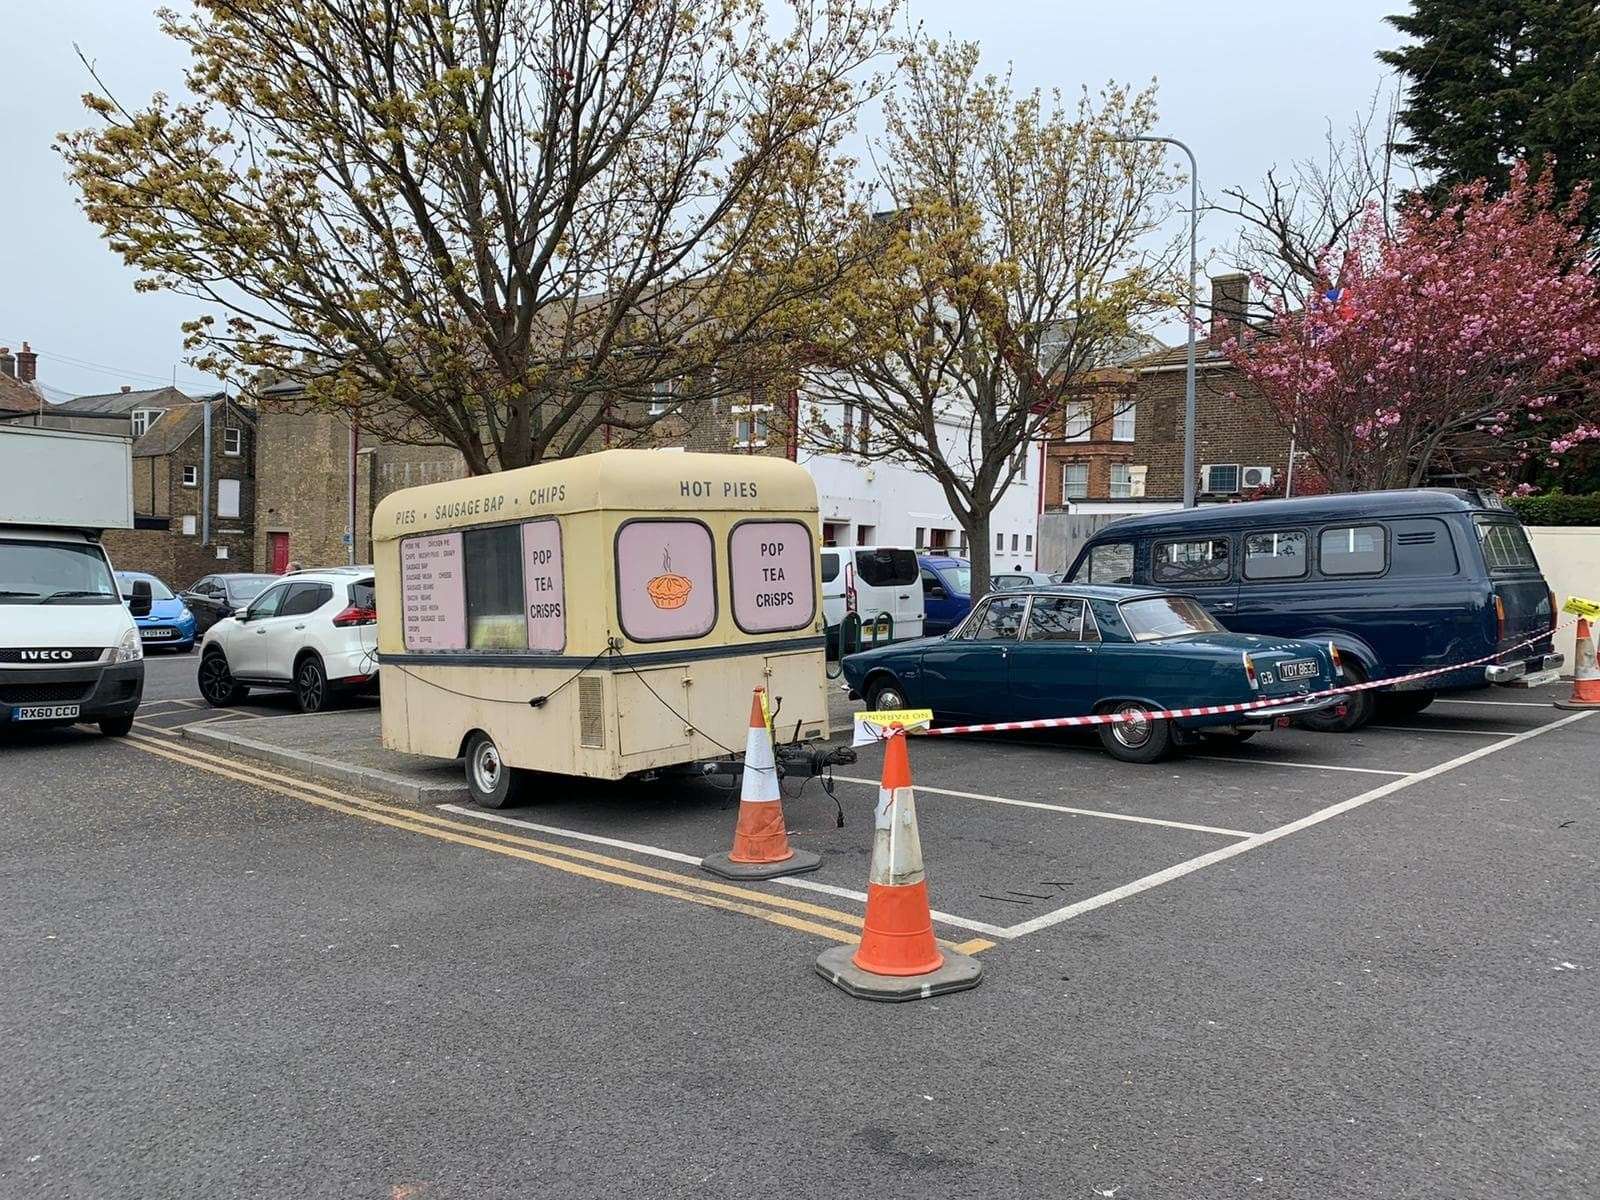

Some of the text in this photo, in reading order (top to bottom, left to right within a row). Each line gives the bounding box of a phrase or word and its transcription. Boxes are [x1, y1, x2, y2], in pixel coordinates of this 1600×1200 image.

[680, 481, 758, 498] HOT PIES
[395, 485, 566, 525] PIES SAUSAGE BAP CHIPS
[532, 549, 552, 565] POP
[760, 543, 785, 557] POP
[762, 567, 786, 582] TEA
[534, 576, 554, 591] TEA
[21, 650, 73, 660] IVECO
[1281, 662, 1317, 678] YOY 863G
[1260, 671, 1274, 685] GB
[20, 706, 79, 719] RX60 CCO
[912, 712, 929, 720] NO
